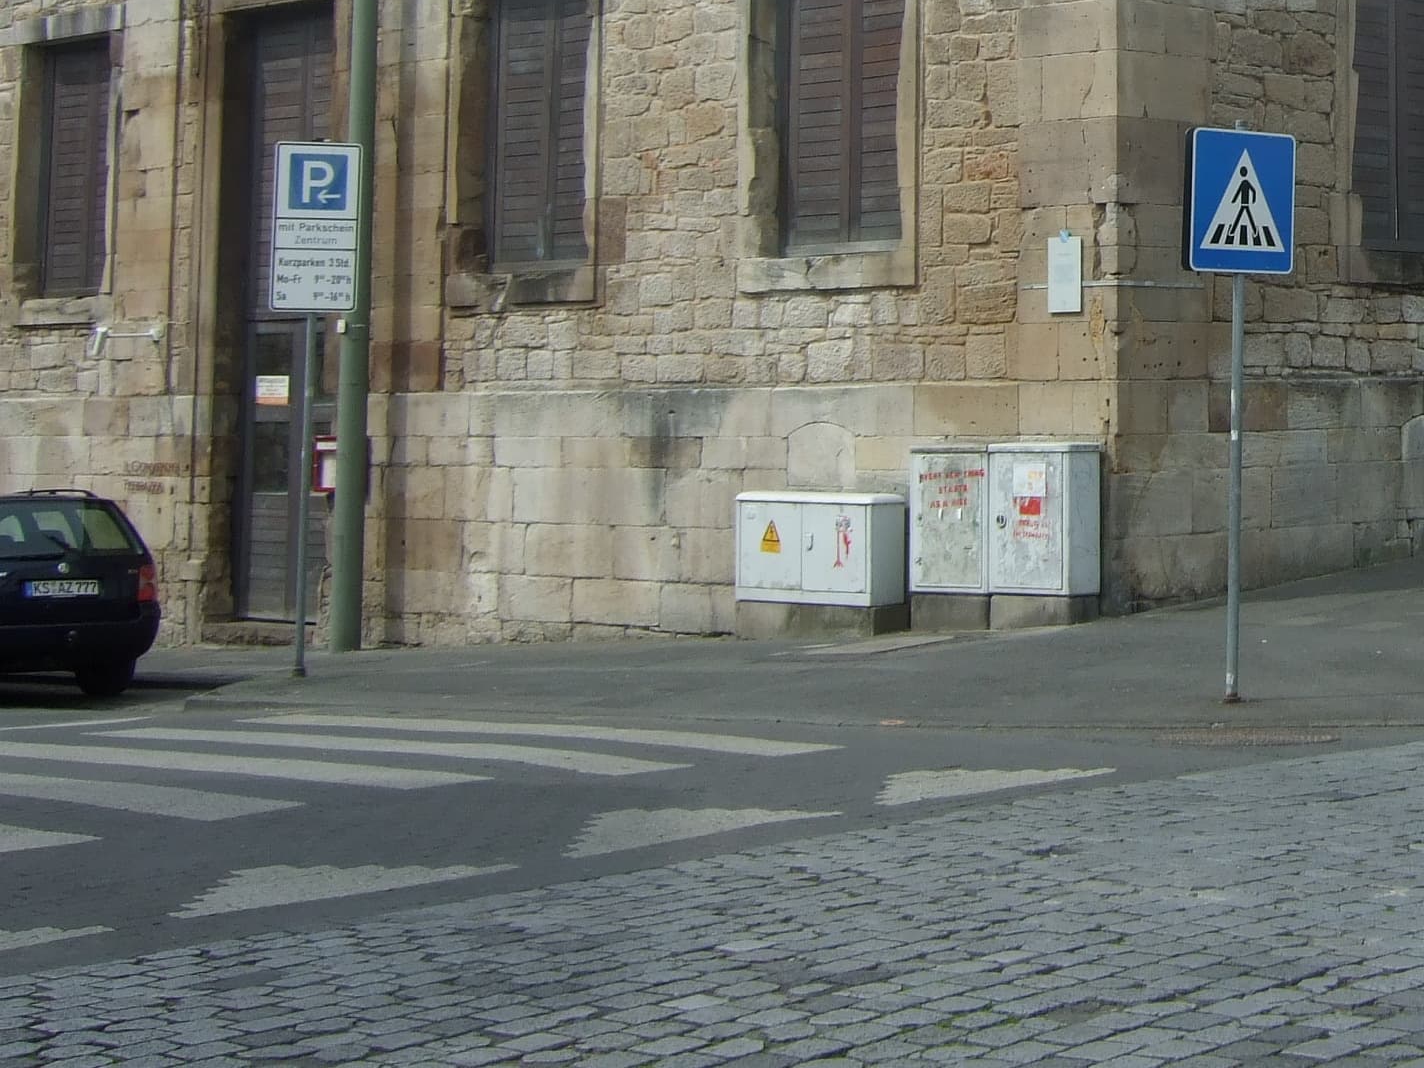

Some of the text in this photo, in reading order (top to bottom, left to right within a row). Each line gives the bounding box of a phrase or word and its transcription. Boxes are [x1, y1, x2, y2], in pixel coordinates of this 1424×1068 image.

[301, 160, 335, 204] P
[279, 222, 355, 233] mit Parkschein
[294, 235, 338, 245] Zentrum
[278, 257, 326, 268] Kurzparken
[275, 291, 287, 301] Sa
[33, 582, 50, 594] KS
[75, 581, 97, 594] 777
